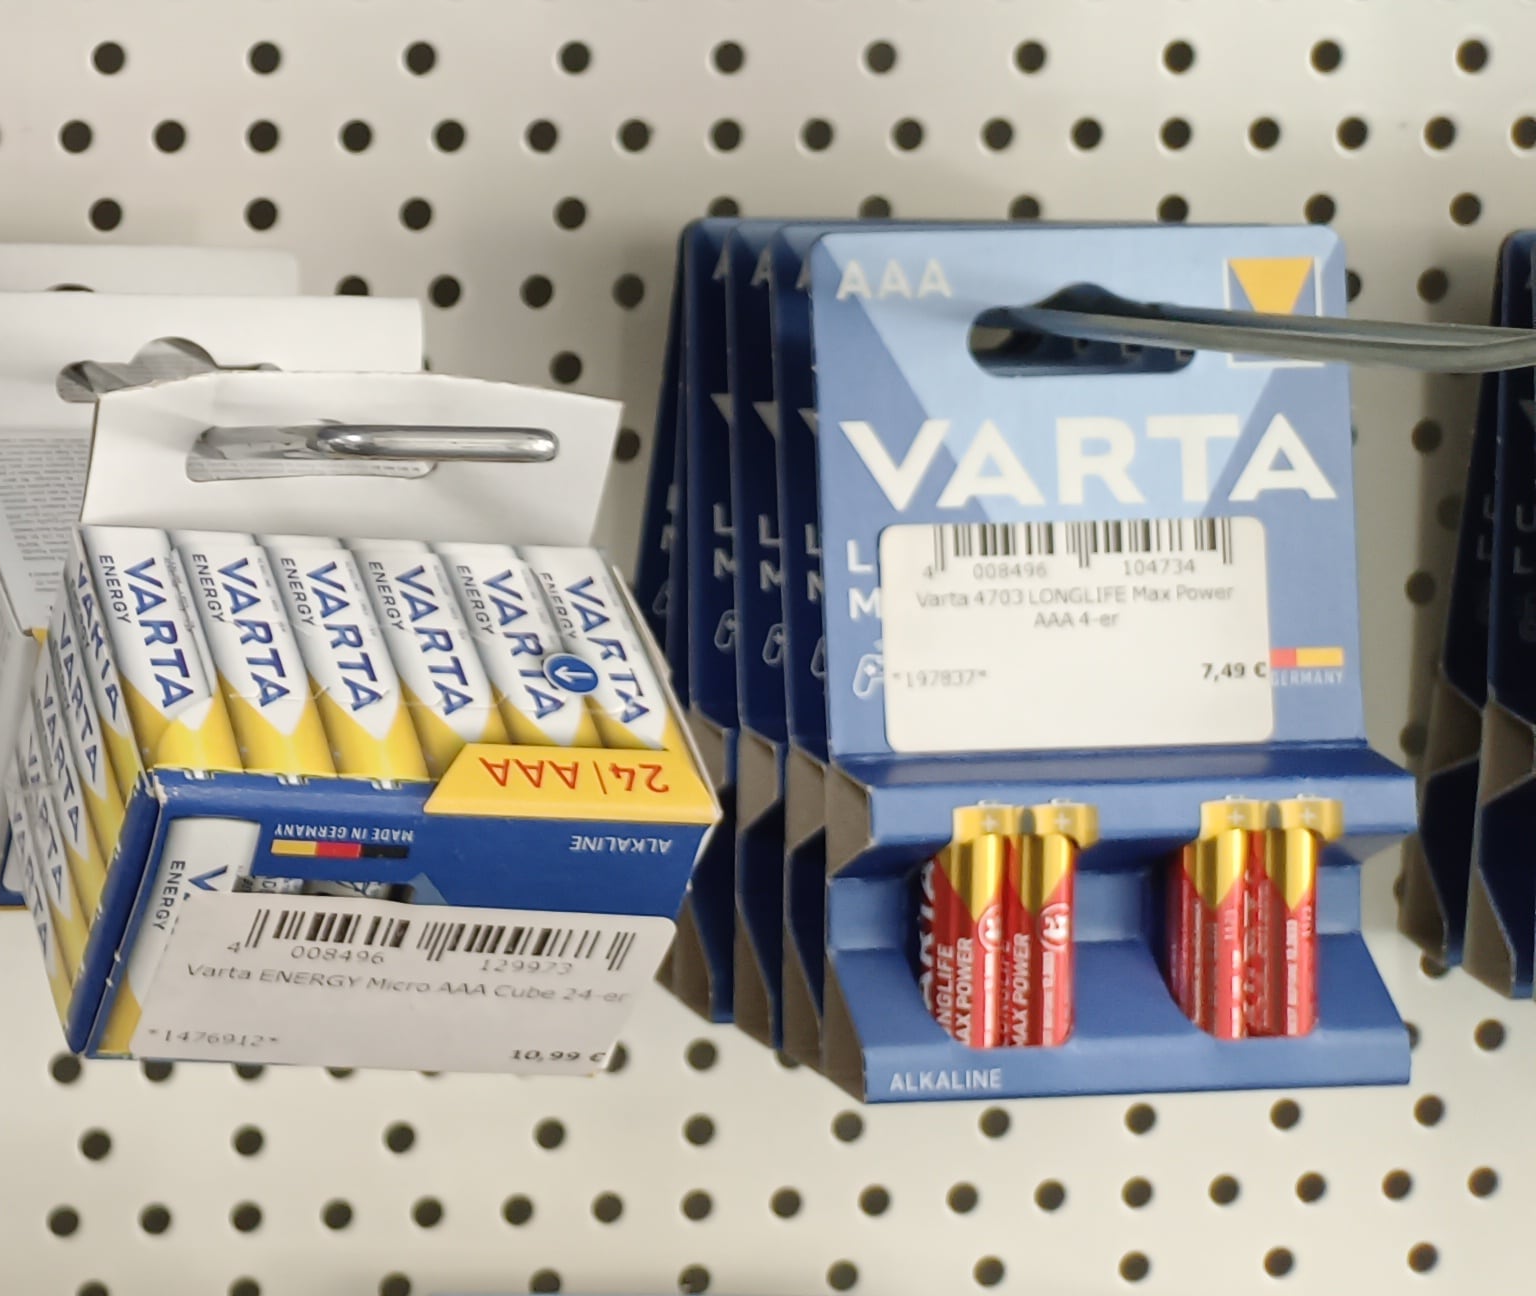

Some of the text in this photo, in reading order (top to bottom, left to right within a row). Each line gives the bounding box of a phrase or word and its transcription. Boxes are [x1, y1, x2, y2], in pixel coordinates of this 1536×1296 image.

[837, 260, 953, 300] AAA
[838, 413, 1337, 512] VARTA
[973, 561, 1048, 581] 008496
[98, 554, 131, 624] ENERGY
[916, 589, 970, 608] Varta
[1029, 585, 1127, 606] LONGLIFE
[1131, 585, 1171, 603] Max
[1176, 584, 1235, 602] Power
[1034, 610, 1074, 629] AAA
[123, 556, 195, 709] VARTA
[1201, 663, 1248, 682] 7,49
[274, 823, 414, 842] MADE GERMANY
[569, 834, 673, 854] ALKALINE
[151, 859, 186, 932] ENERGY
[187, 964, 555, 1002] Varta ENERGY Micro Cube
[890, 1067, 1003, 1092] ALKALINE
